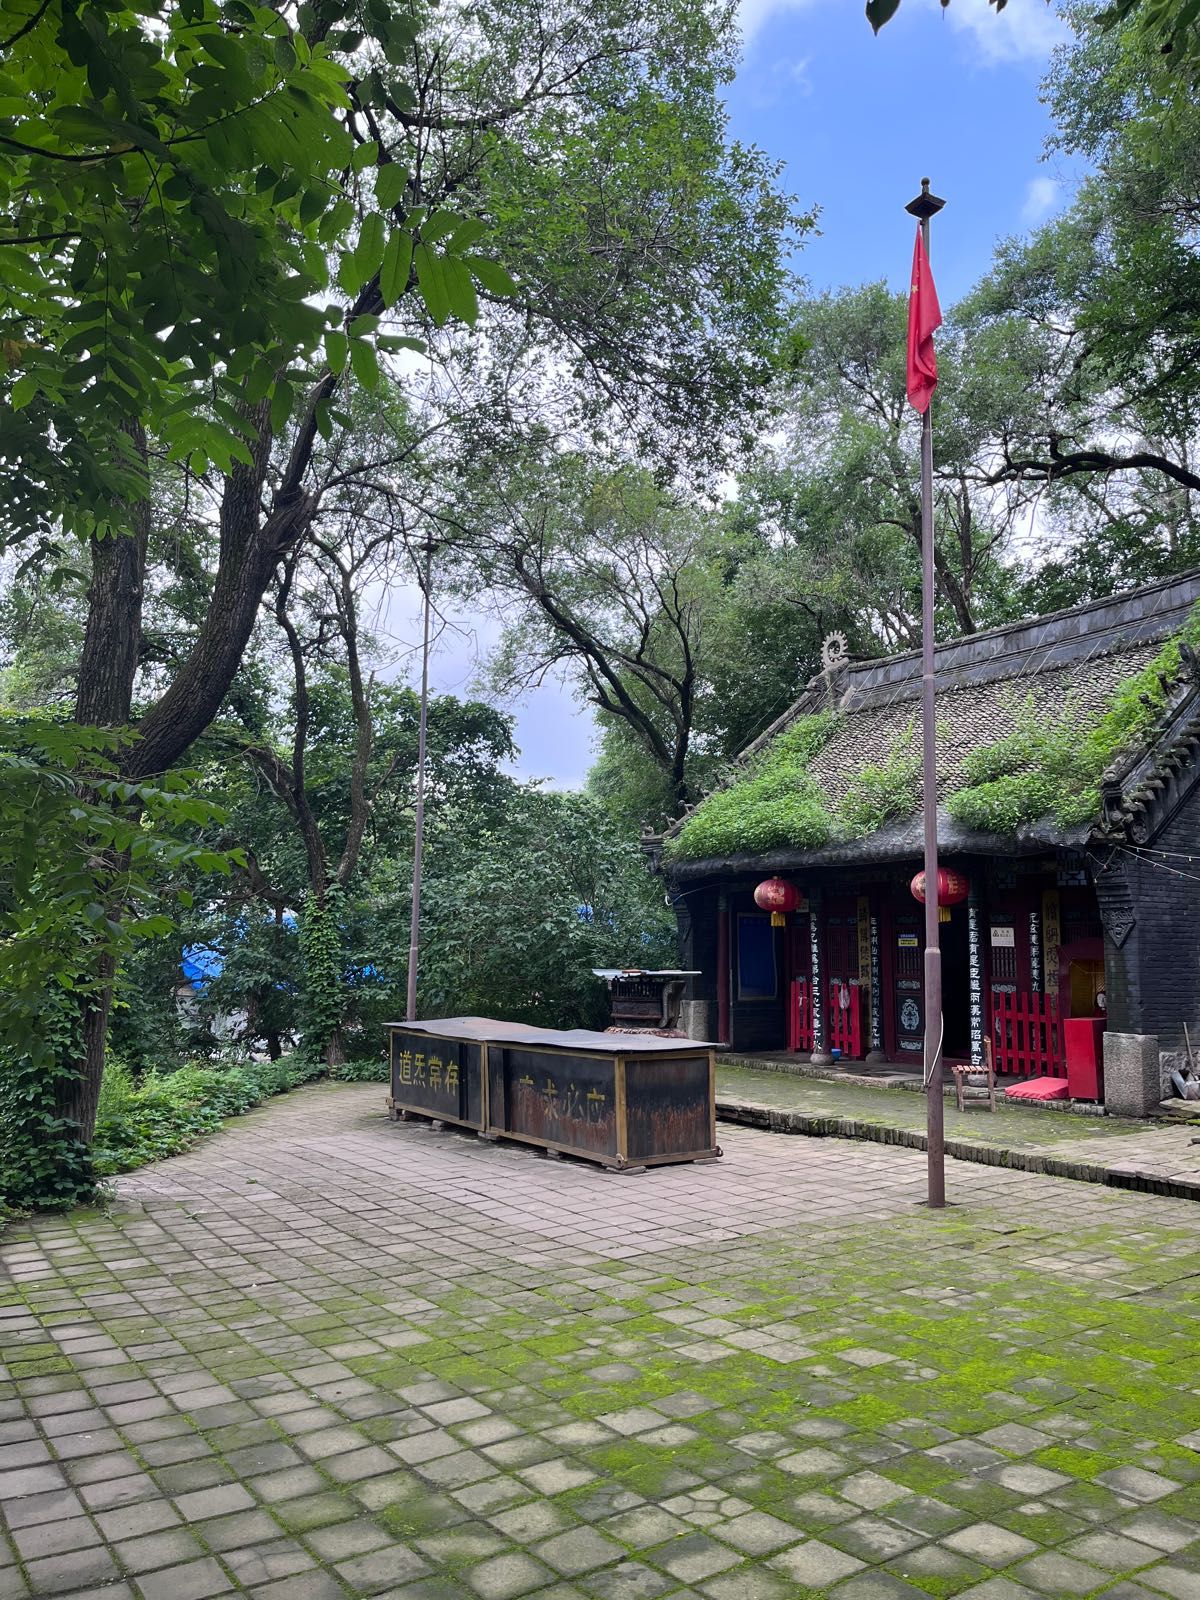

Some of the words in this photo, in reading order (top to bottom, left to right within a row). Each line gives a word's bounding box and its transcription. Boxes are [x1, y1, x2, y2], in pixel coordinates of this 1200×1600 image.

[399, 1050, 459, 1096] 道炁常存
[520, 1075, 605, 1125] 求必应
